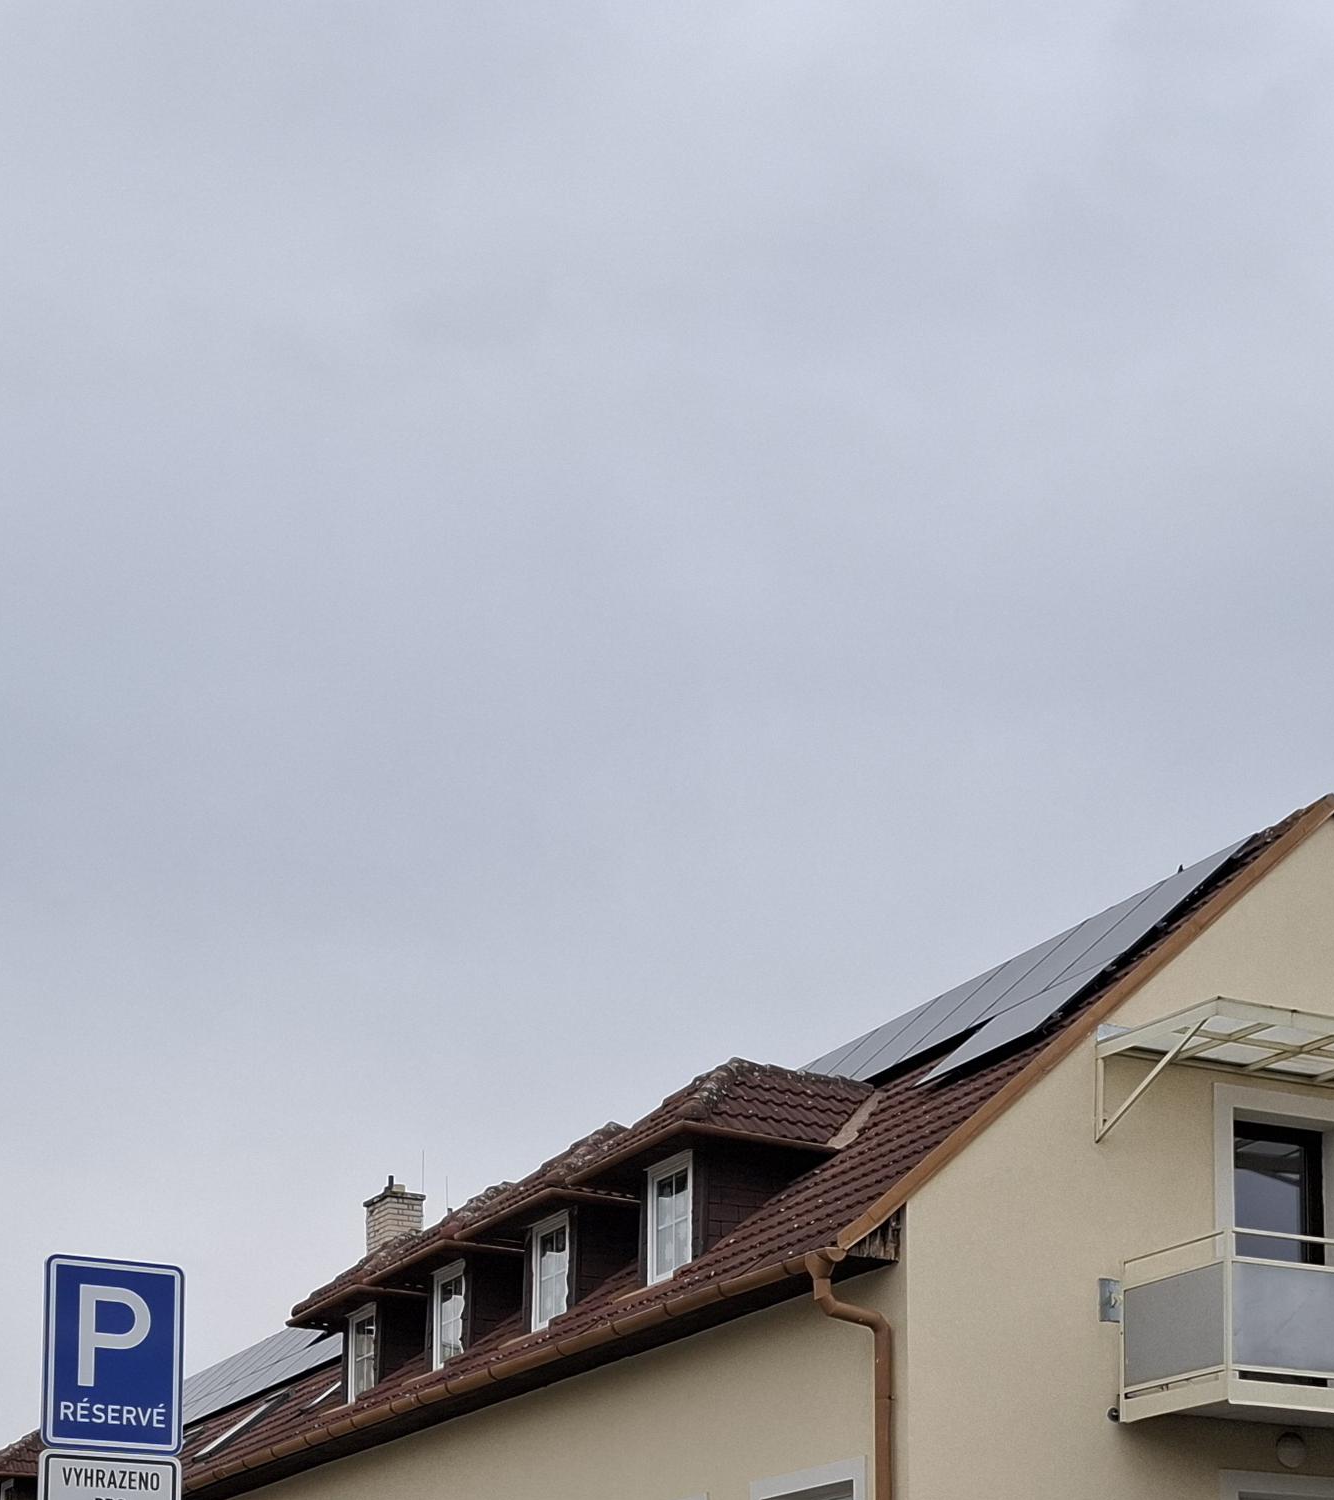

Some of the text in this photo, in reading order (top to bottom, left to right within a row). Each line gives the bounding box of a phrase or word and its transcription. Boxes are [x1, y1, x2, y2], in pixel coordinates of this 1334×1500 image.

[78, 1283, 151, 1387] P
[59, 1398, 166, 1428] RÉSERVÉ
[62, 1466, 161, 1492] VYHRAZENO
